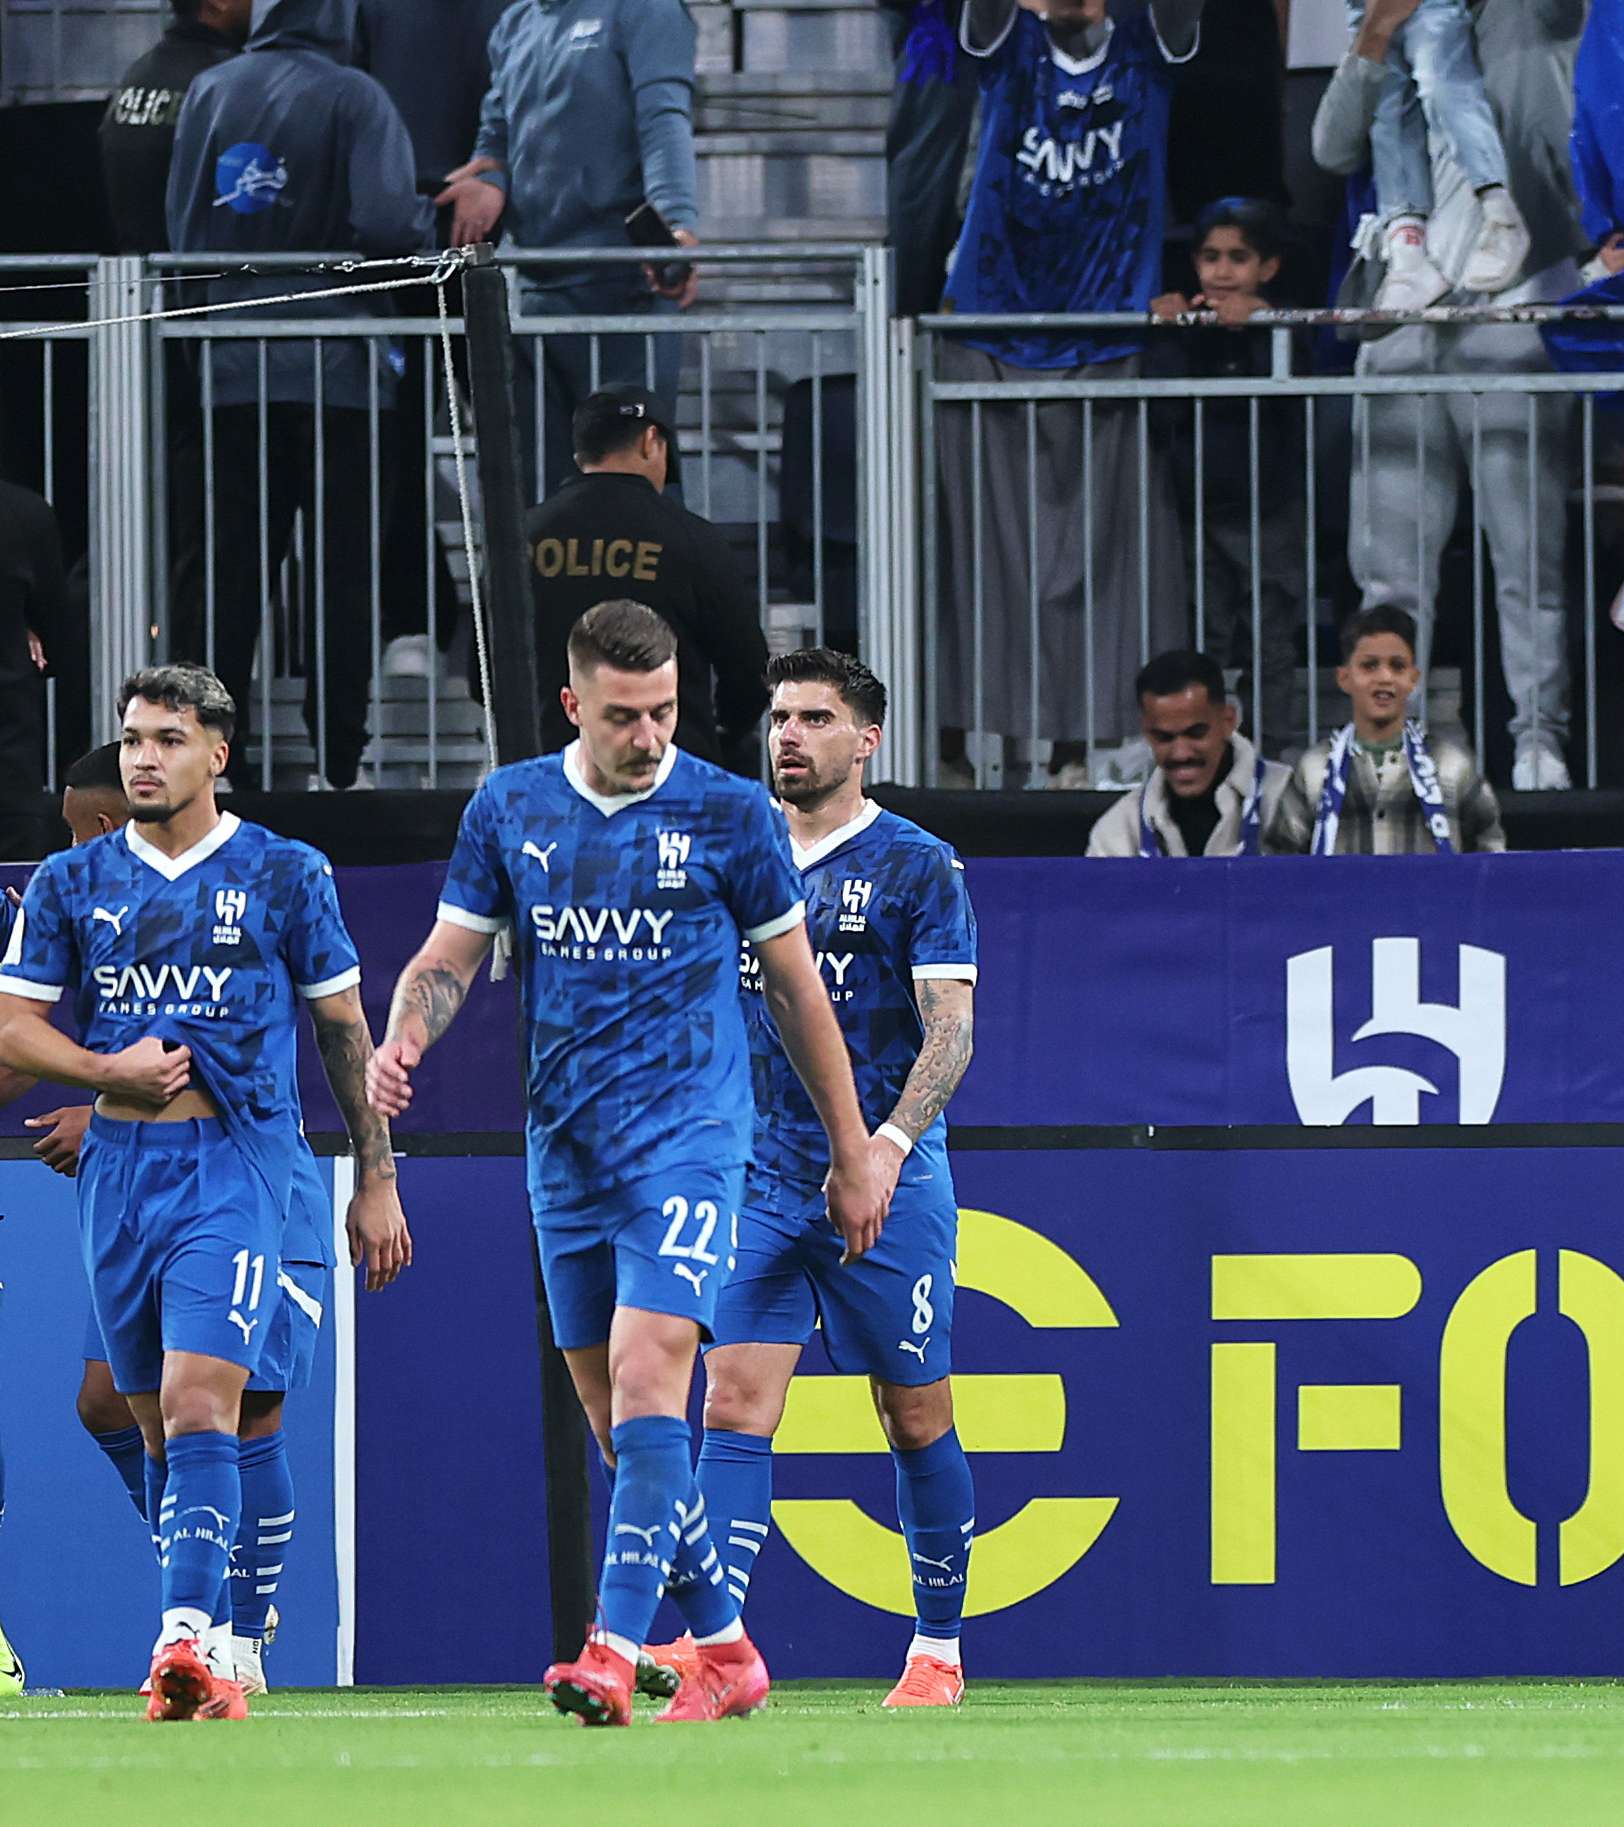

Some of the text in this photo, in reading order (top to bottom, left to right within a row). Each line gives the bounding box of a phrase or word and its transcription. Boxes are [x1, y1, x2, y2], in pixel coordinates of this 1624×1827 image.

[115, 86, 181, 125] OLIC
[528, 537, 663, 581] OLICE
[531, 904, 674, 945] SAVVY
[604, 947, 672, 961] GROUP
[93, 964, 232, 1002] SAVVY
[164, 1003, 229, 1018] GROUP
[658, 1195, 720, 1266] 22
[232, 1248, 265, 1311] 11
[912, 1274, 934, 1335] 8
